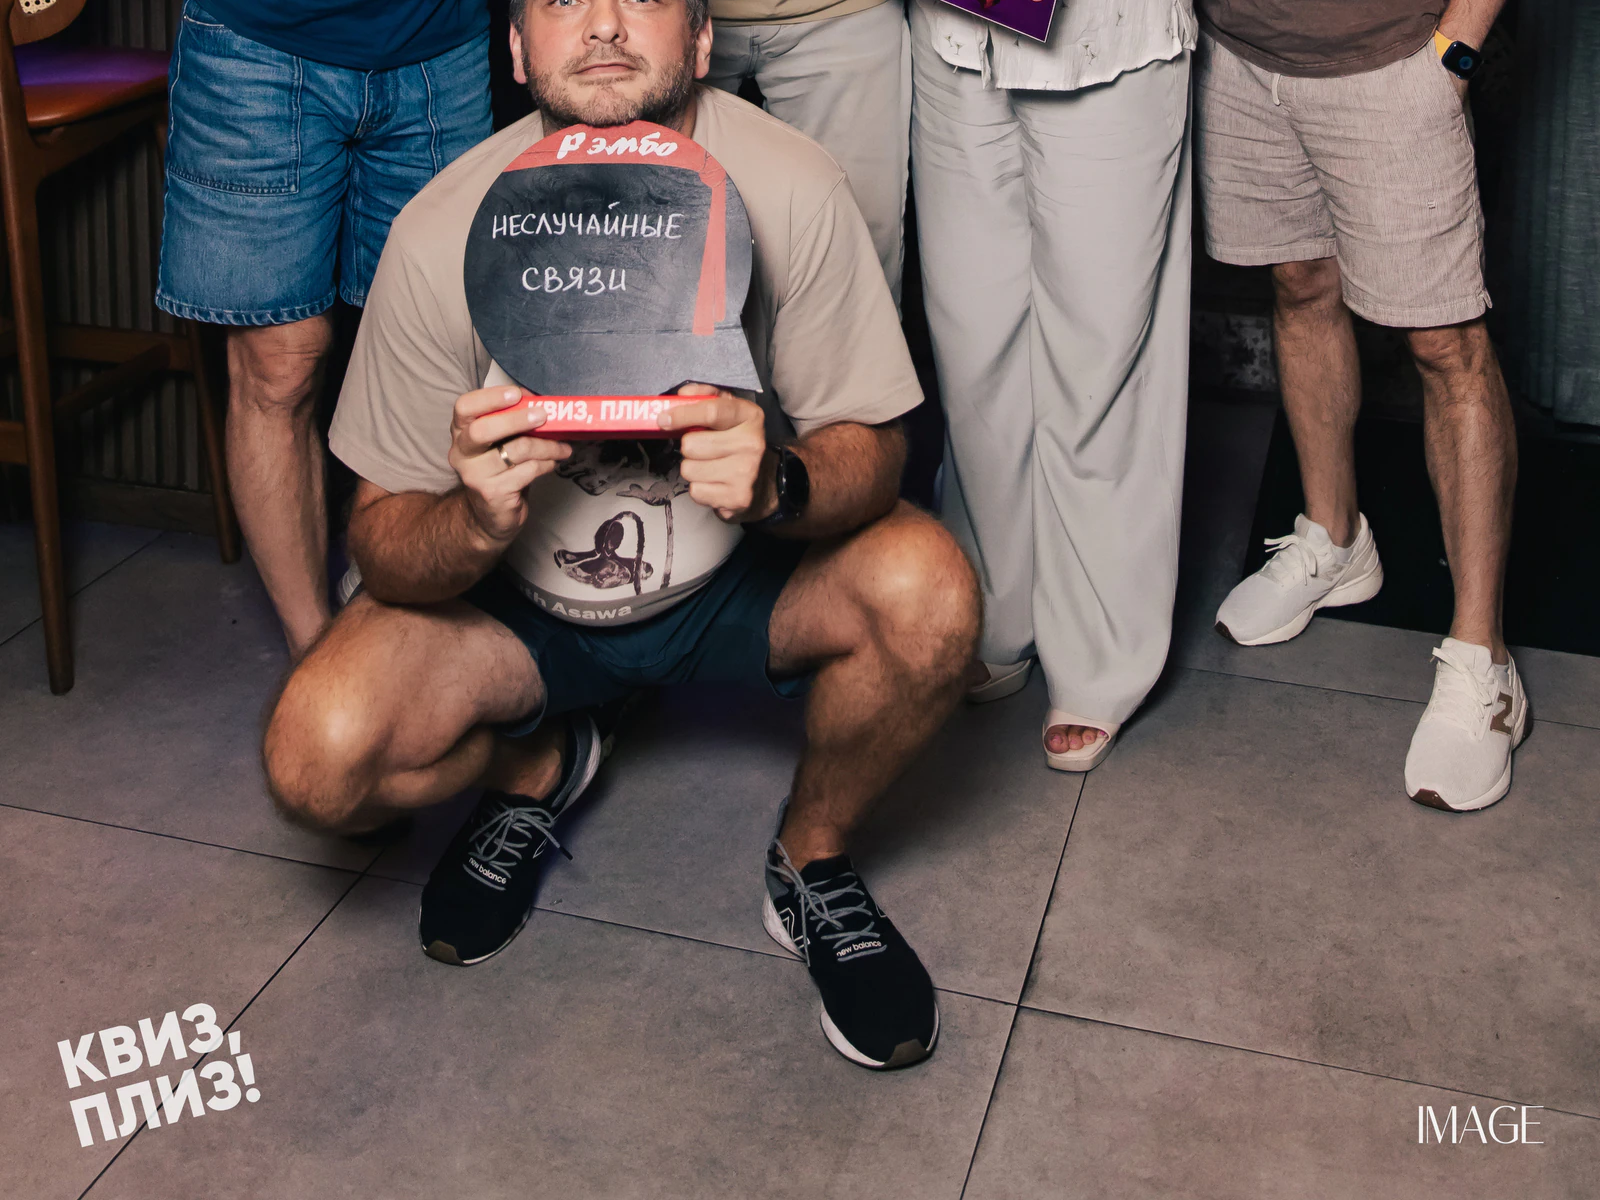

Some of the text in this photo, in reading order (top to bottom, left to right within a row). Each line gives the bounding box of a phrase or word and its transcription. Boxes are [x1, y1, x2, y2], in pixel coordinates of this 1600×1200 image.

[556, 131, 679, 160] Рэмбо
[492, 201, 685, 240] НЕСЛУЧАЙНЫЕ
[522, 266, 627, 296] СВЯЗИ
[551, 602, 633, 620] Asawa
[469, 857, 507, 885] new balance
[836, 940, 882, 957] new balance
